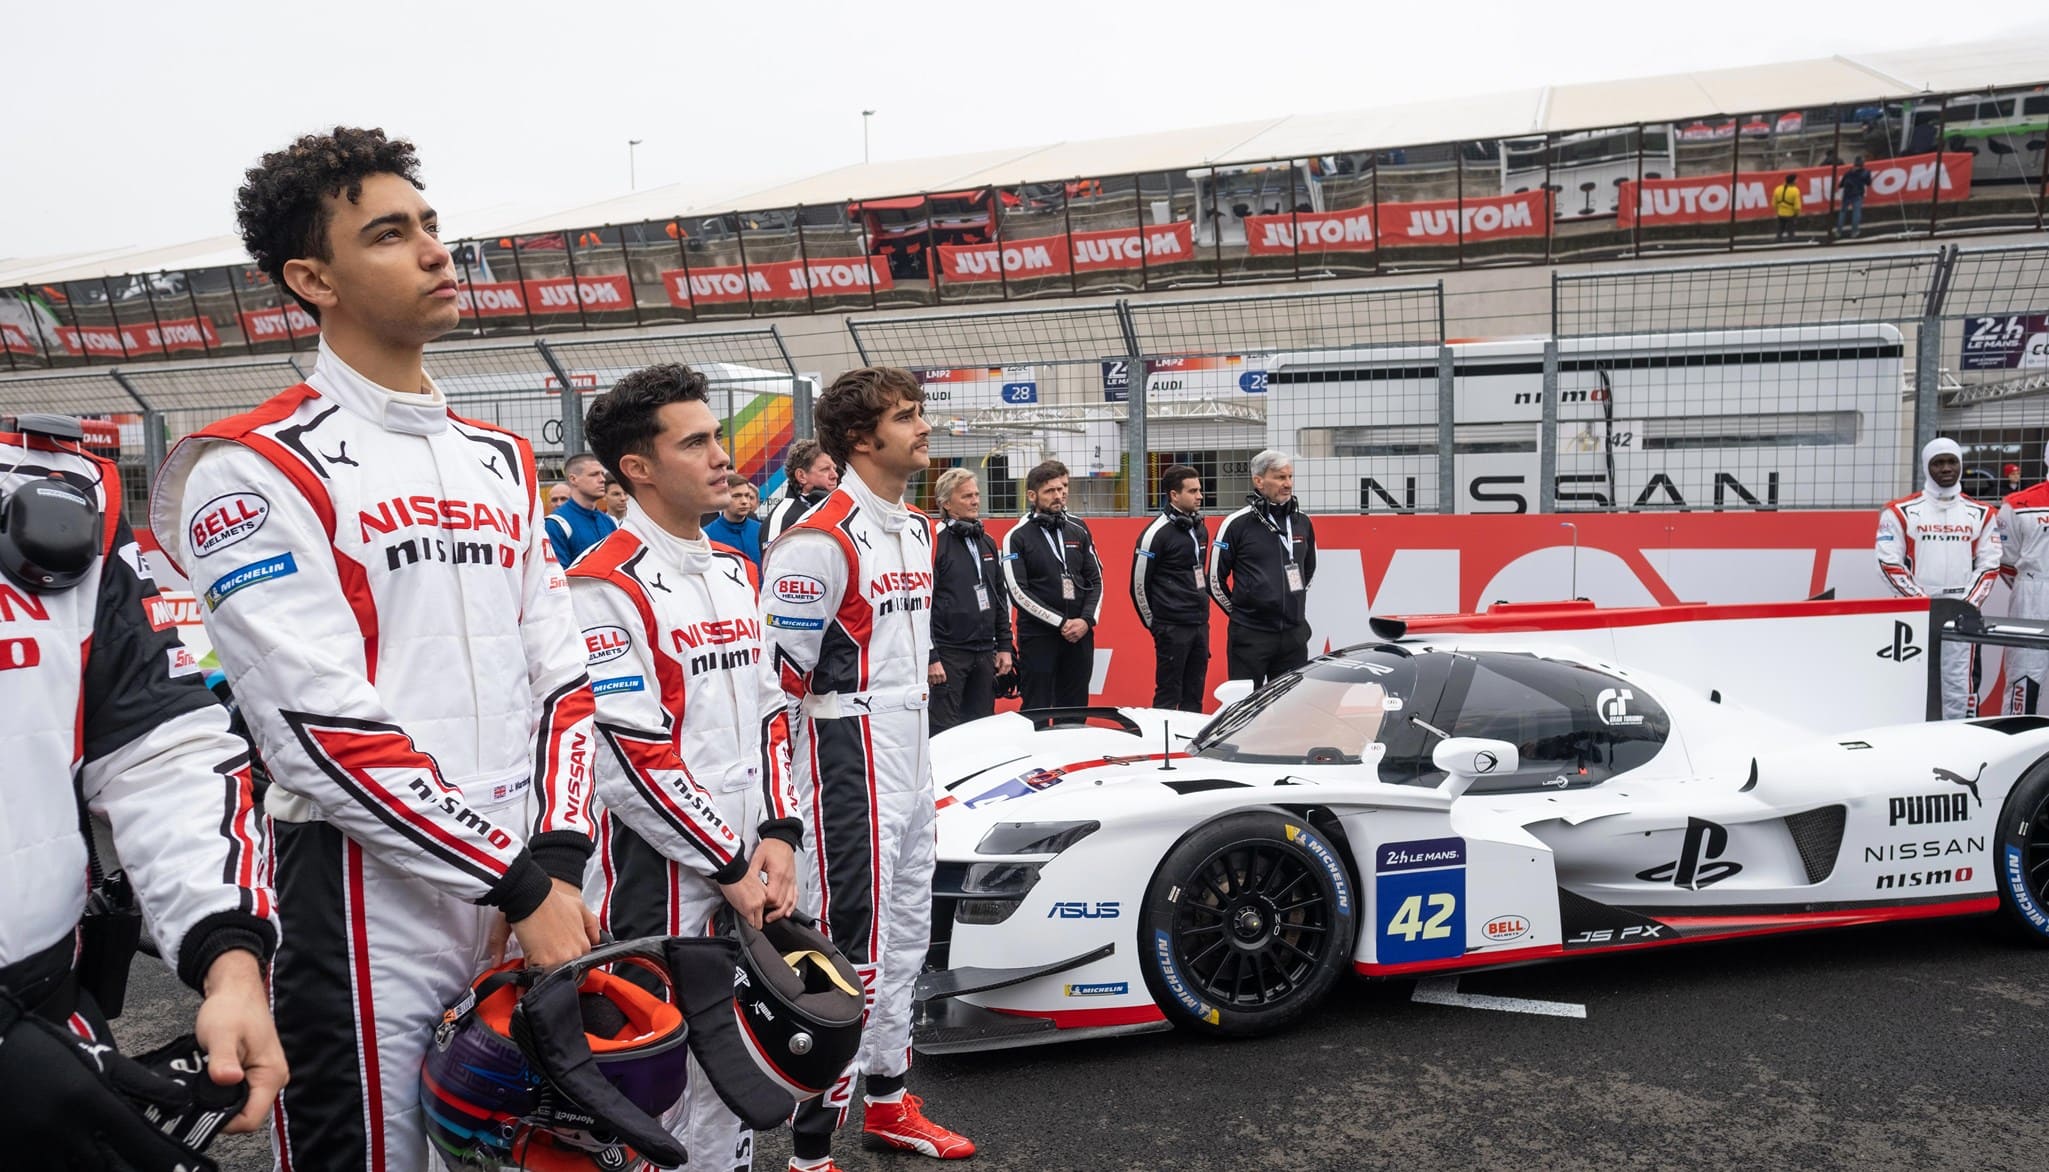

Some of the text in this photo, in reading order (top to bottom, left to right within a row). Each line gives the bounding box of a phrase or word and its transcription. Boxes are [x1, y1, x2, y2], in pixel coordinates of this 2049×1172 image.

[1967, 339, 2019, 349] LE MANS
[925, 369, 951, 379] LMP2
[1250, 375, 1268, 389] 28
[1011, 386, 1030, 400] 28
[1151, 380, 1182, 392] AUDI
[925, 391, 951, 402] AUDI
[1514, 389, 1609, 404] nimo
[1612, 432, 1633, 447] 42
[1360, 471, 1779, 515] NSSAN
[193, 498, 259, 547] BELL
[358, 495, 521, 545] NISSAN
[203, 520, 255, 551] HELMETS
[1917, 524, 1973, 535] NISSAN
[1921, 534, 1971, 542] nismo
[385, 537, 516, 571] nismo
[221, 561, 285, 593] MICHELIN
[778, 580, 821, 595] BELL
[781, 619, 818, 628] MICHELIN
[586, 631, 625, 653] ELL
[588, 647, 622, 660] ELMETS
[691, 648, 761, 676] nimo
[593, 680, 639, 693] MICHELIN
[563, 732, 587, 824] NISSAN
[1889, 793, 1968, 826] PUMA
[1386, 850, 1457, 865] 24h LE MANS
[1865, 836, 1985, 863] NISSAN
[1308, 841, 1349, 908] MICHELIN
[1876, 867, 1973, 889] nismo
[2008, 853, 2046, 927] MICHELIN
[1047, 902, 1120, 918] ASUS
[1387, 892, 1456, 942] 42
[1488, 920, 1524, 934] BELL
[1568, 925, 1664, 943] JS PX
[1157, 937, 1198, 1009] MICHELIN
[1082, 986, 1123, 994] MICHELIN
